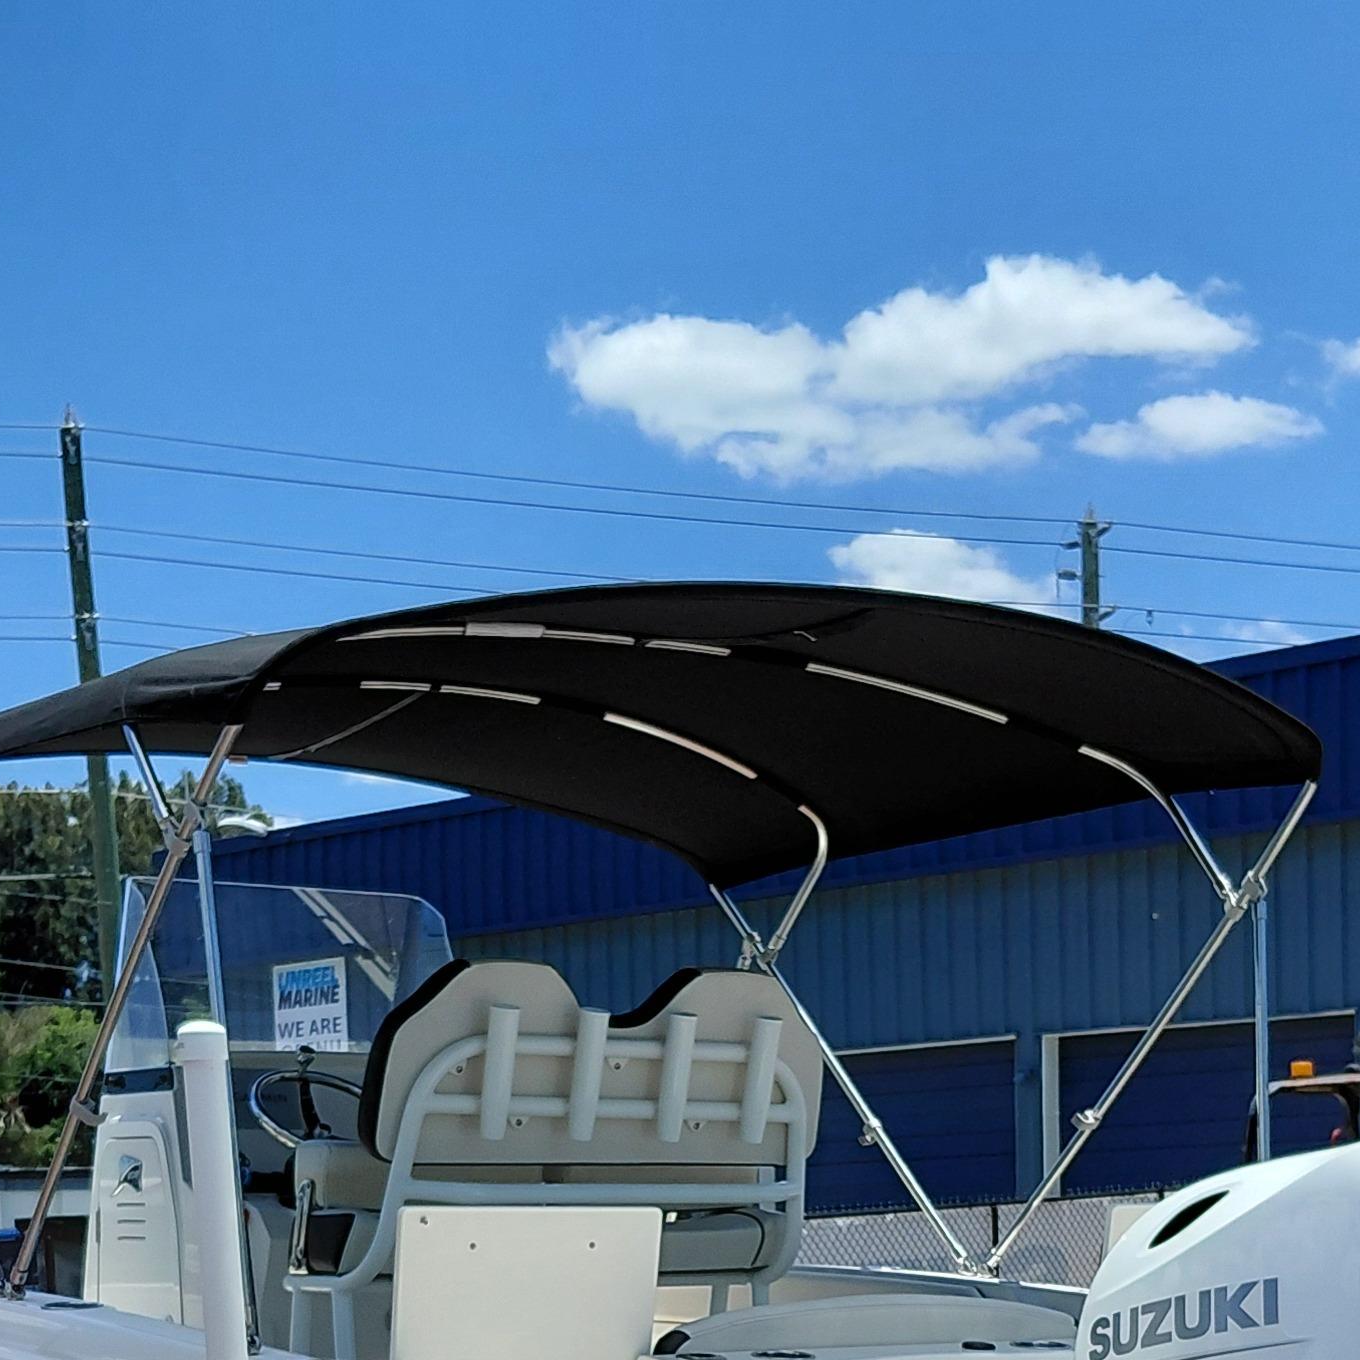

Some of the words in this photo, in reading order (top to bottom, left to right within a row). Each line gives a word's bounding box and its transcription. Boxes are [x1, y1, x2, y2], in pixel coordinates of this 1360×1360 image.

[278, 966, 339, 992] UNREEL
[277, 984, 341, 1011] MARINE
[277, 1020, 305, 1039] WE
[309, 1016, 342, 1037] ARE
